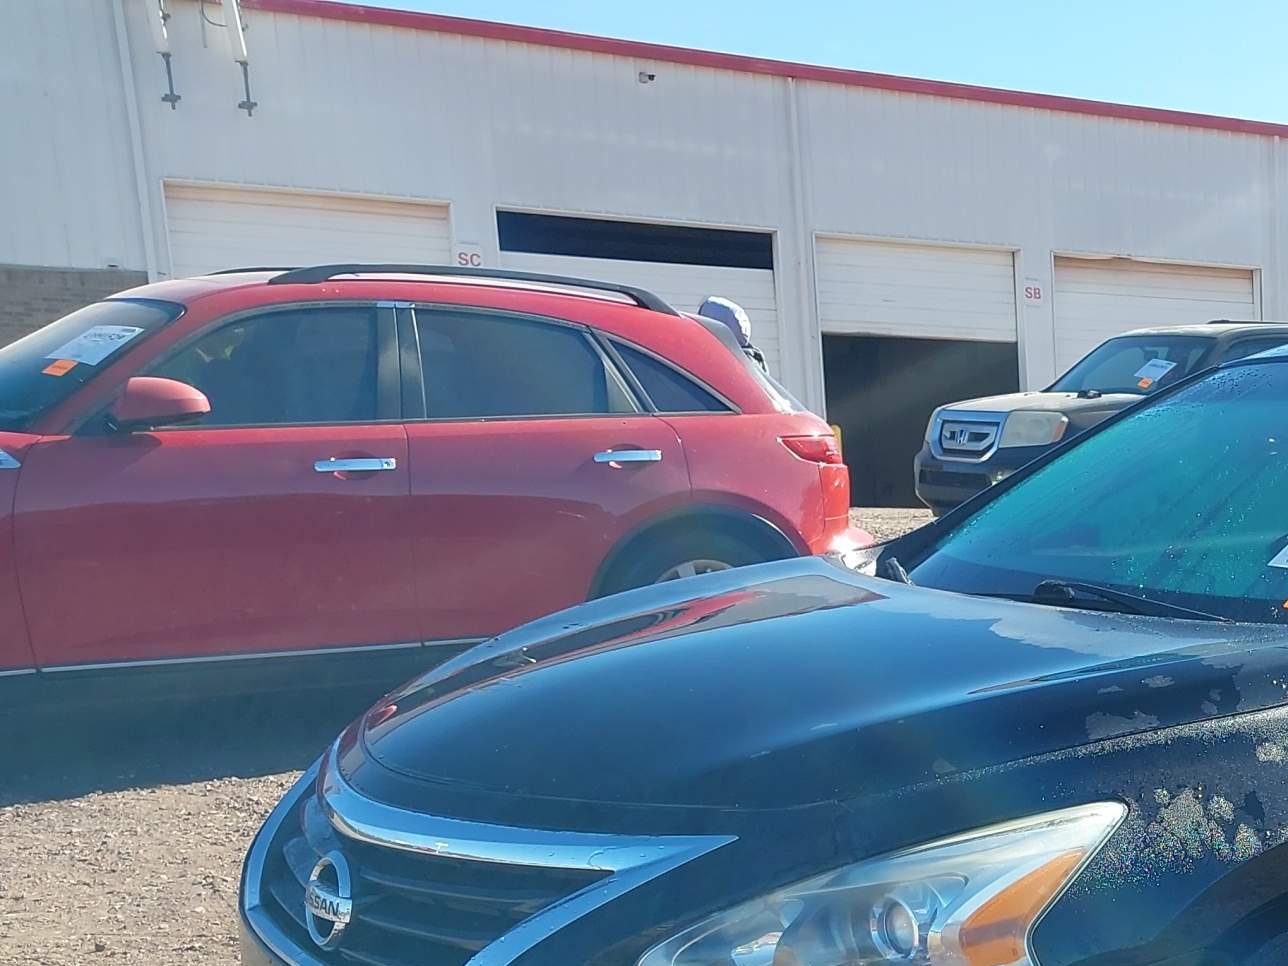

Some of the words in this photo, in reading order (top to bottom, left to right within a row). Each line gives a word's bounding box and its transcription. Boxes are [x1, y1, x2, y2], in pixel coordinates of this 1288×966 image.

[458, 252, 481, 267] SC
[1025, 286, 1041, 299] SB
[306, 888, 341, 917] SSAN
